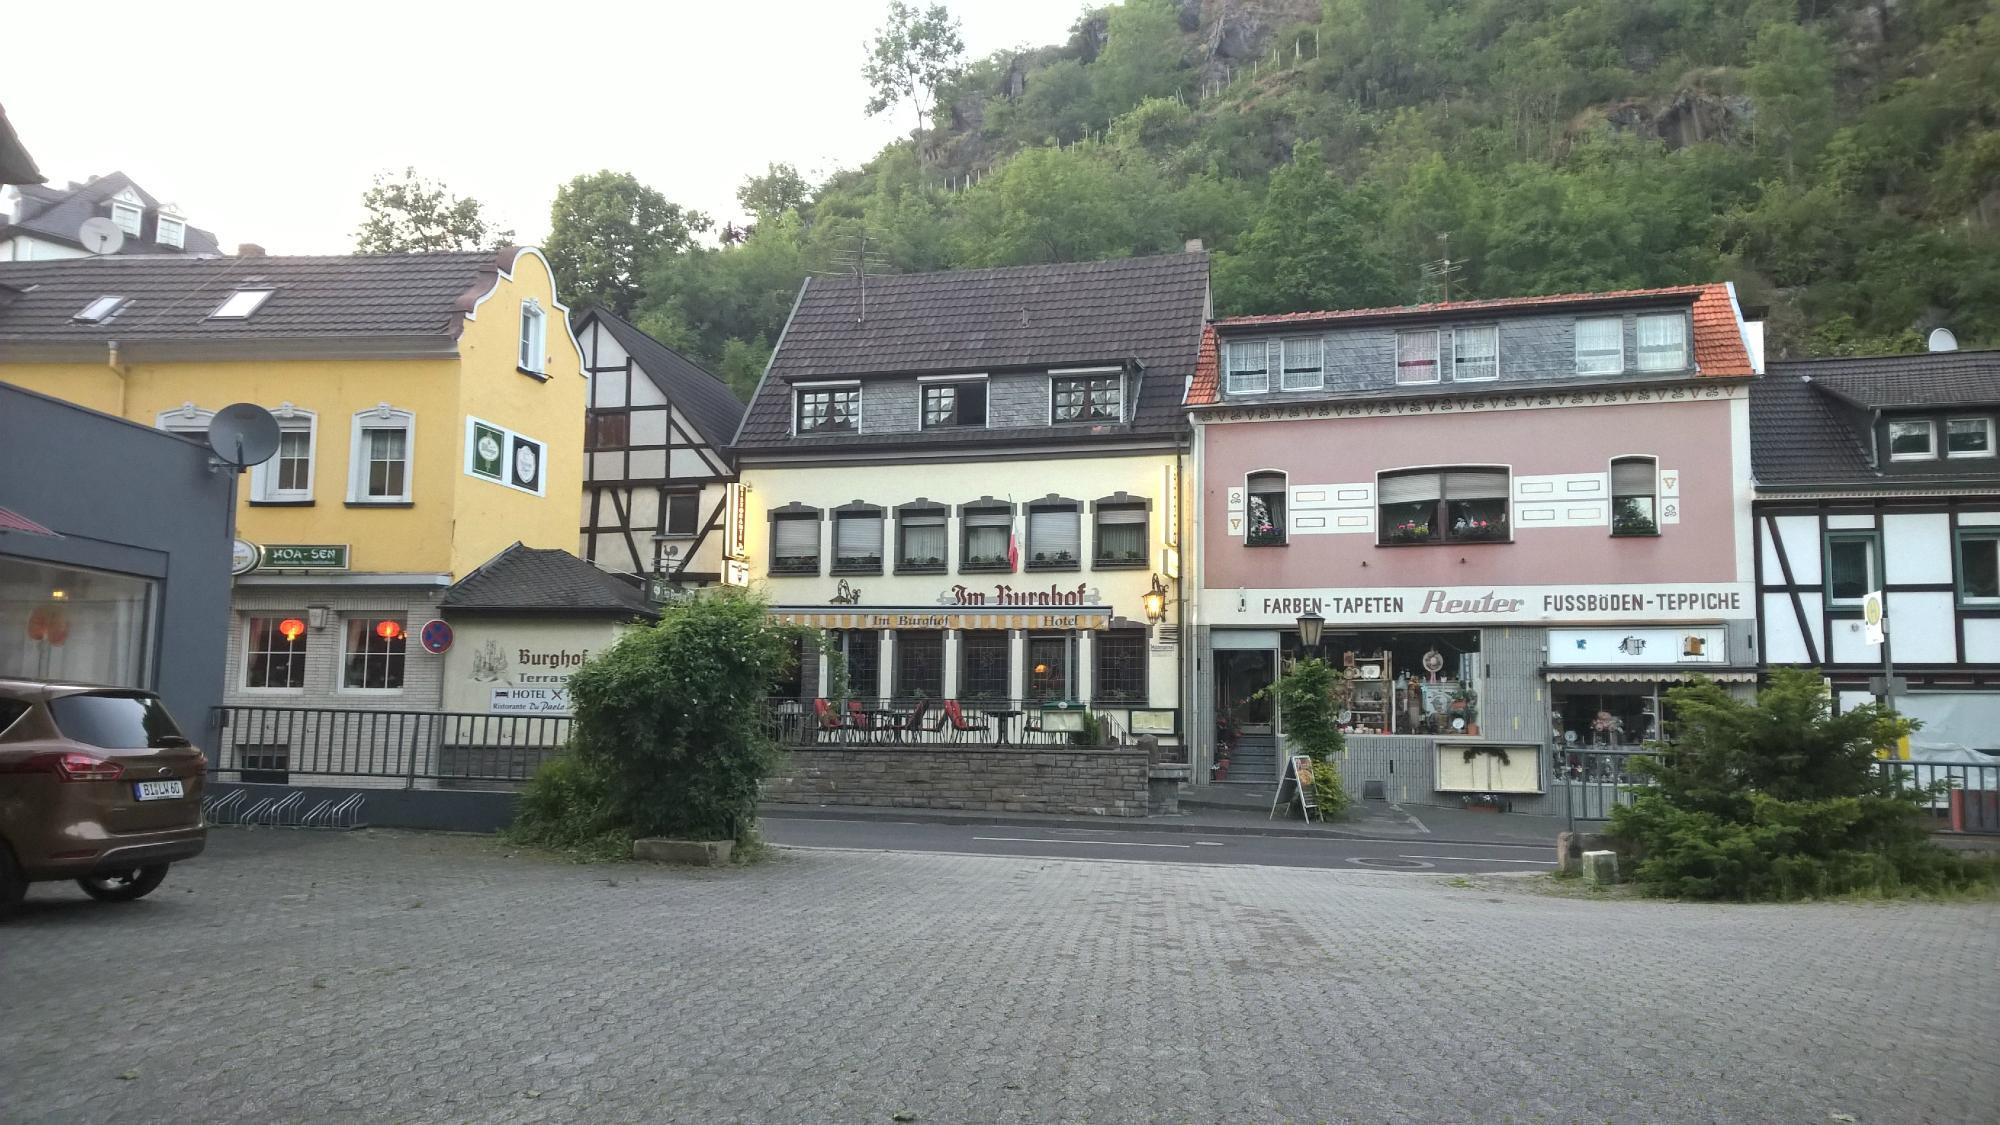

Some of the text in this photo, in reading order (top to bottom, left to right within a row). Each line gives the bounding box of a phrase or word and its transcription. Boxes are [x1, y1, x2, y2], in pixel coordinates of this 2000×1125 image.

[951, 584, 986, 606] Im
[1419, 590, 1525, 614] Reuter
[1043, 614, 1079, 627] Hotel
[518, 648, 590, 669] Burghof
[519, 672, 568, 683] Terras
[512, 689, 547, 699] HOTEL
